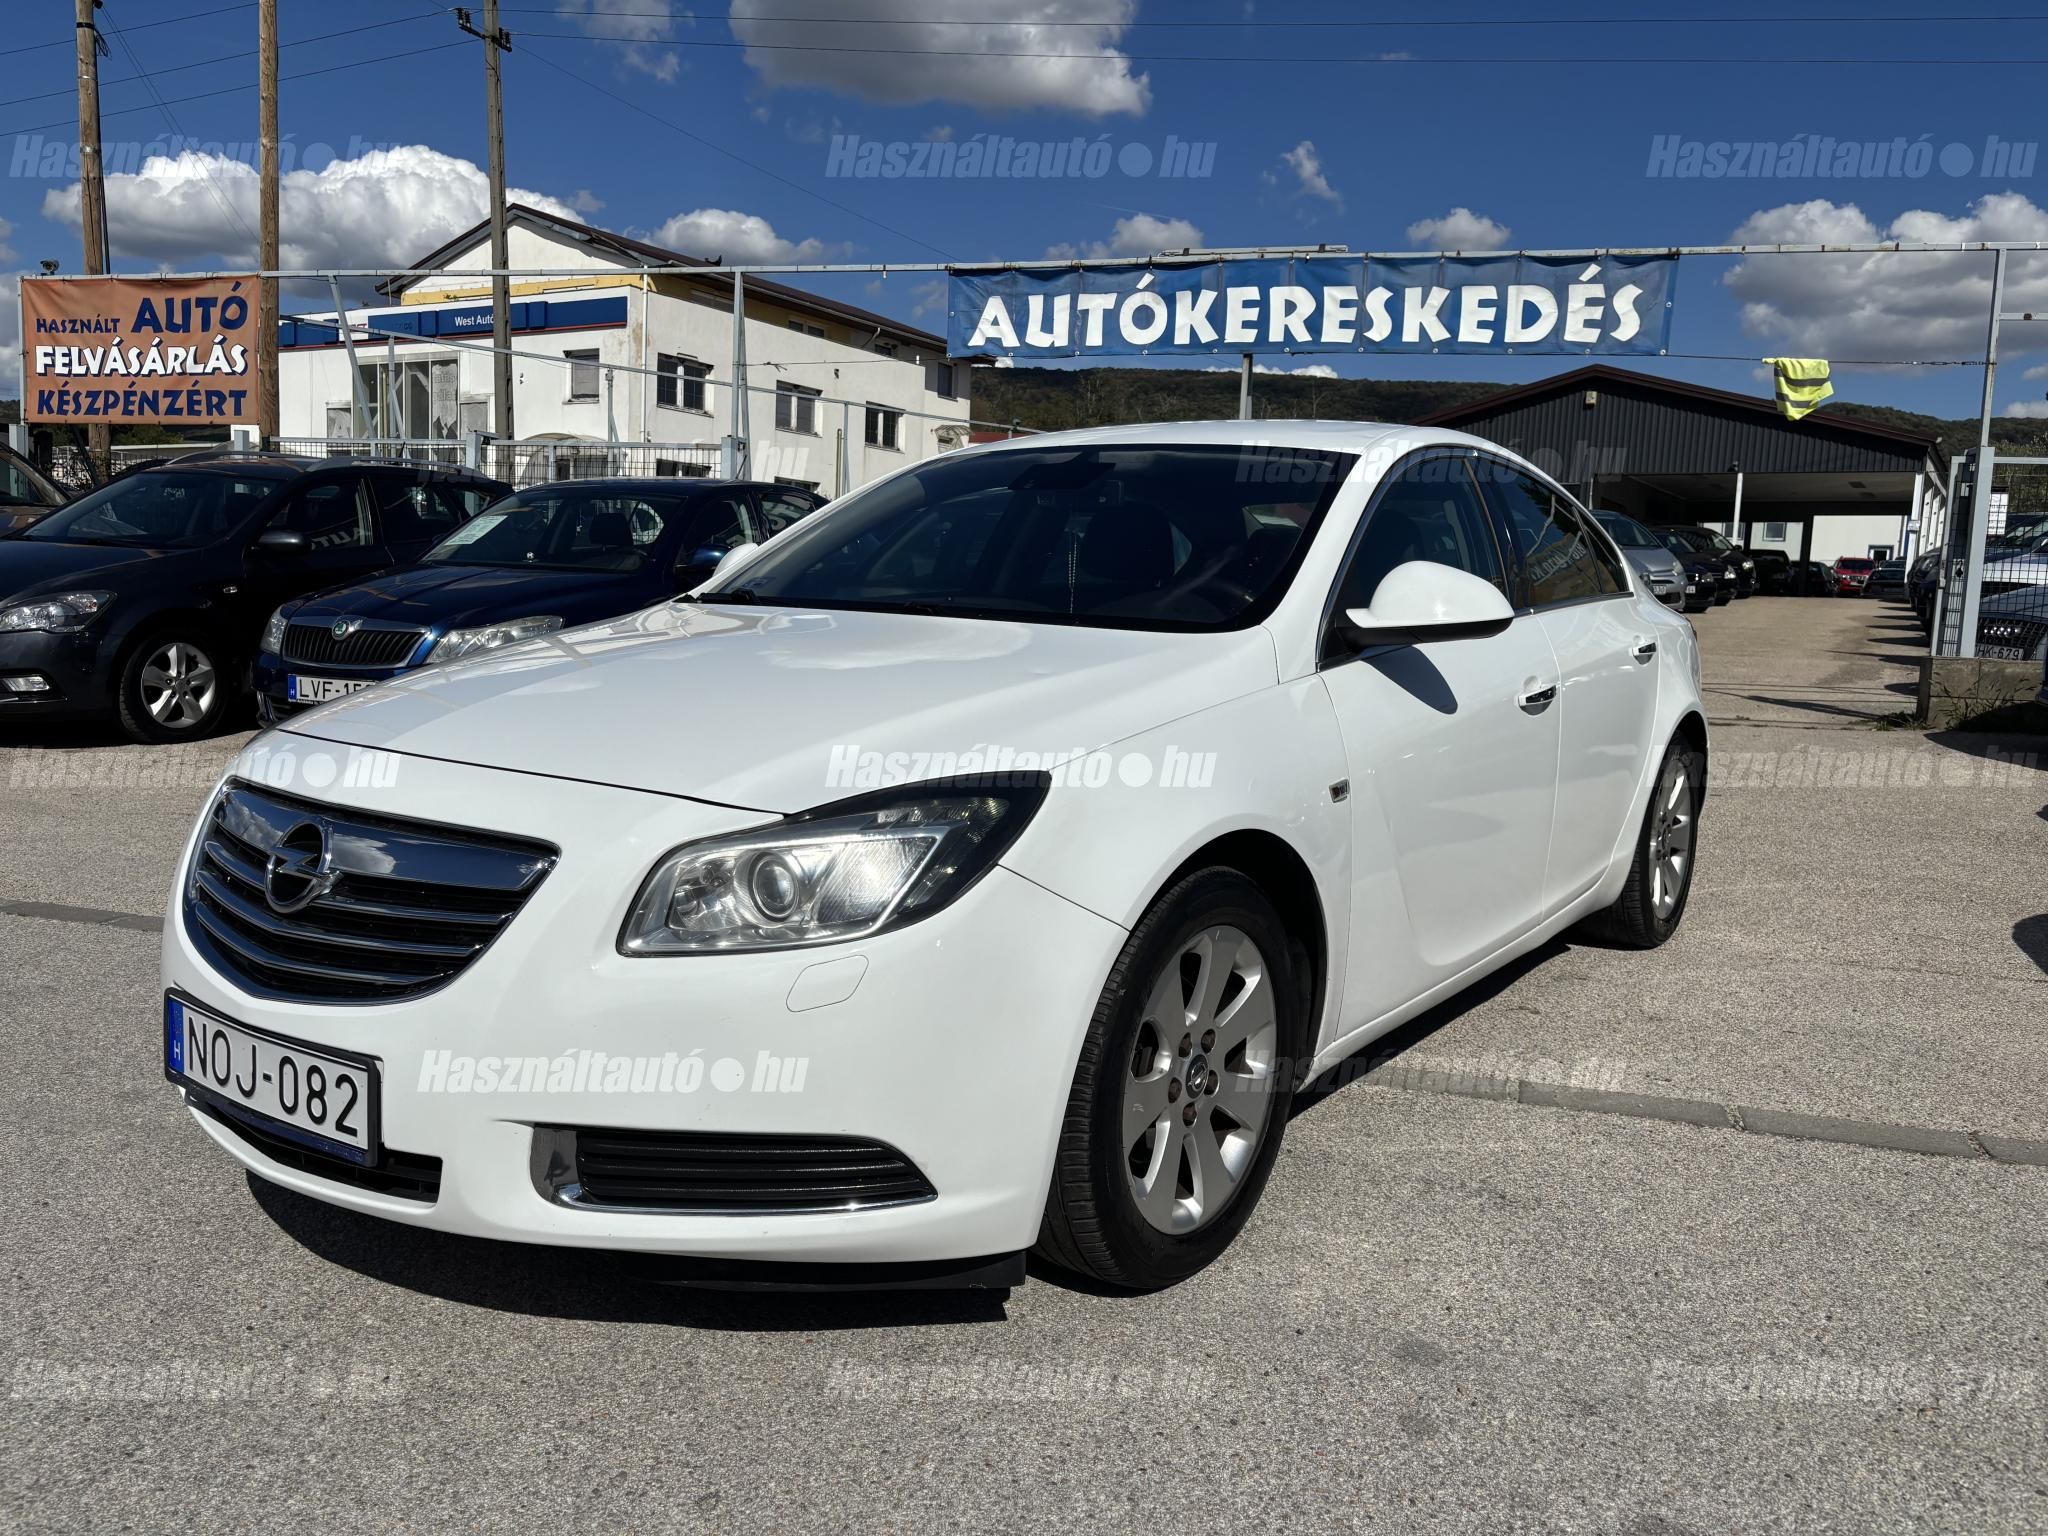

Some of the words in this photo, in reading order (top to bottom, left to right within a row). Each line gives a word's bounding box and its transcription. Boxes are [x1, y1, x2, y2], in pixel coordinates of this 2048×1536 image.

[36, 313, 120, 333] HASZNÁLT
[131, 280, 248, 333] AUTÓ
[454, 316, 475, 327] West
[967, 264, 1643, 348] AUTÓKERESKEDÉS
[35, 333, 248, 376] FELVÁSÁRLÁS
[37, 379, 247, 417] KÉSZPÉNZÉRT
[173, 1040, 181, 1061] H
[188, 1016, 358, 1137] NOJ-082
